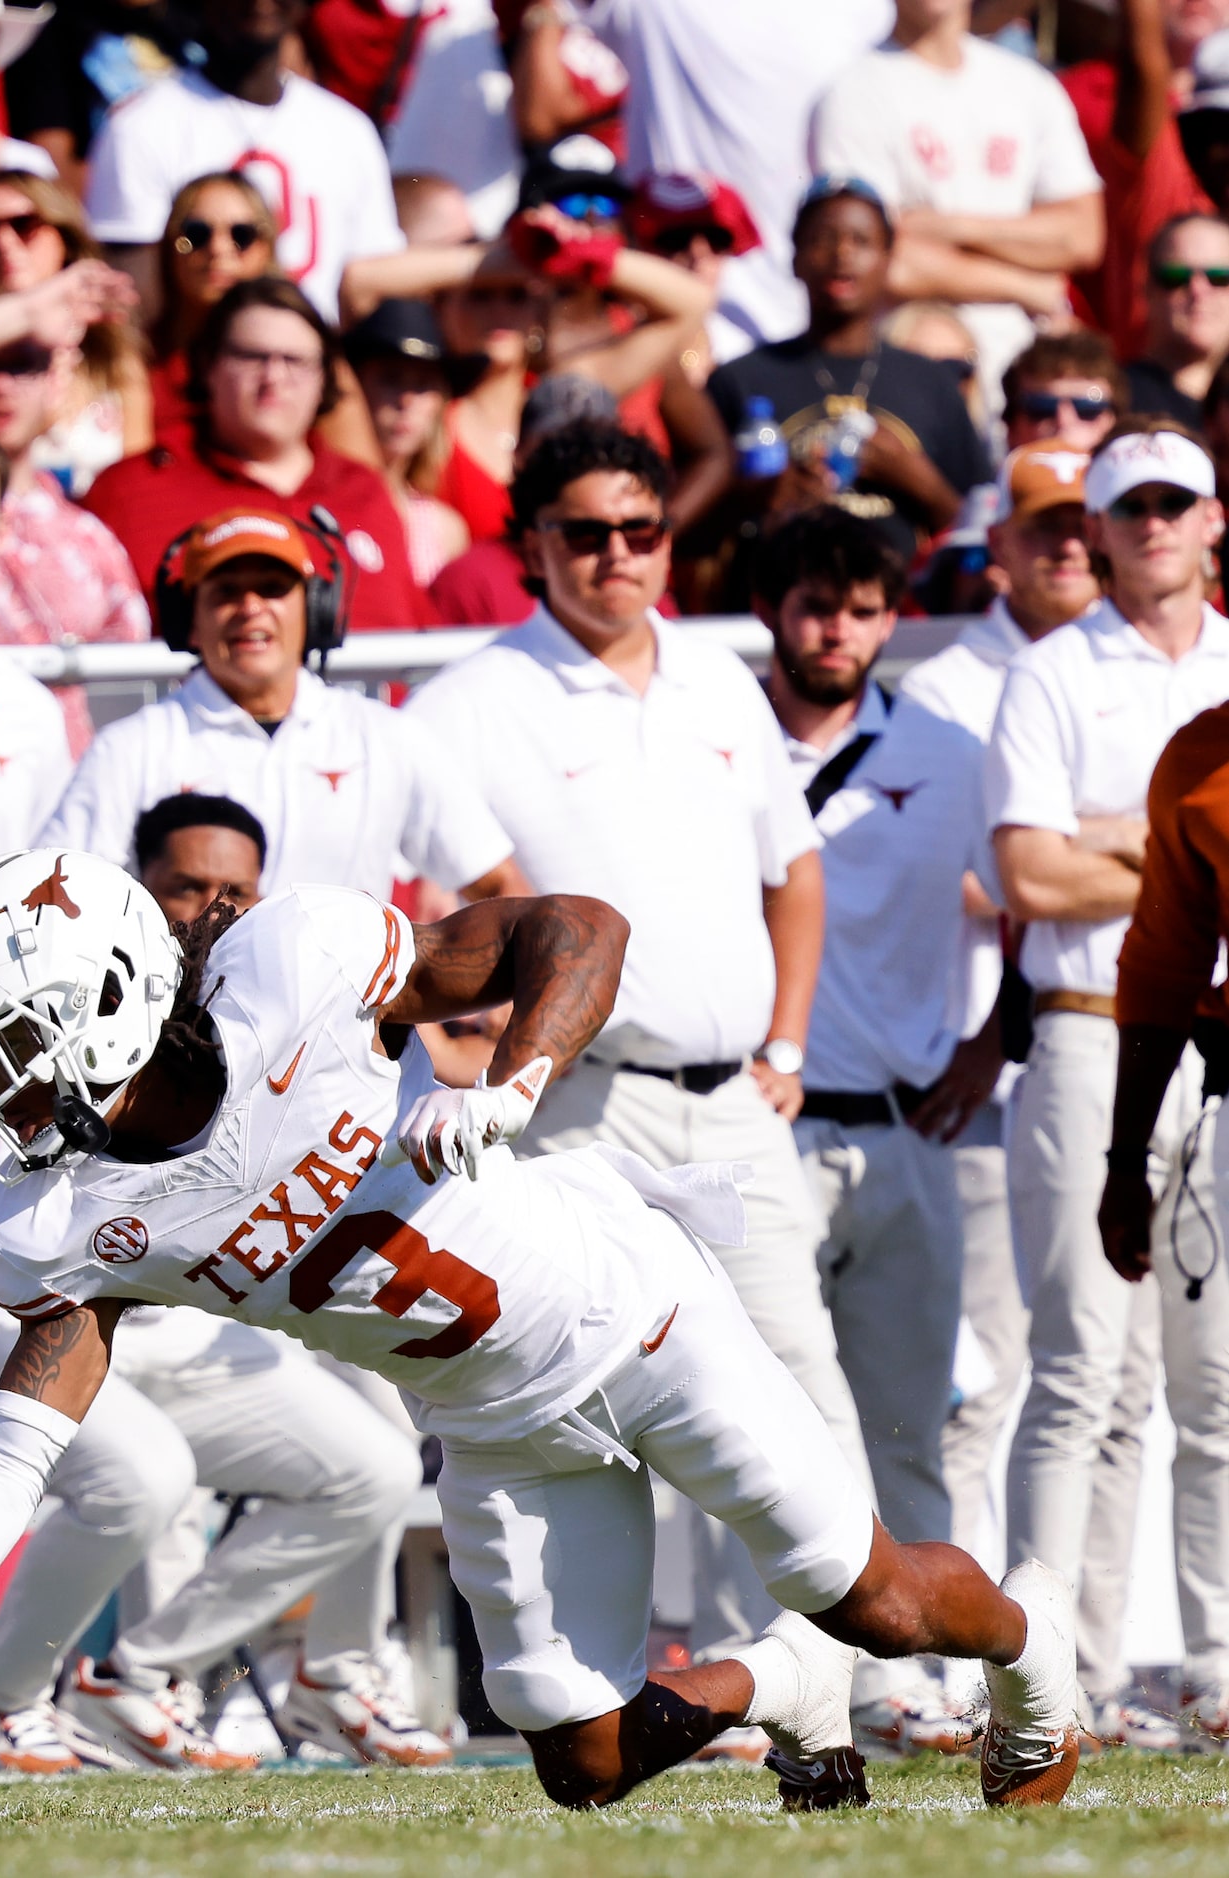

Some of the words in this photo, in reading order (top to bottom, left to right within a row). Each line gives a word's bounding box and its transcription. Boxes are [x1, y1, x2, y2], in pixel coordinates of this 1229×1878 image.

[94, 1217, 148, 1263] SEC
[183, 1110, 383, 1305] TEXAS
[289, 1209, 502, 1360] 3
